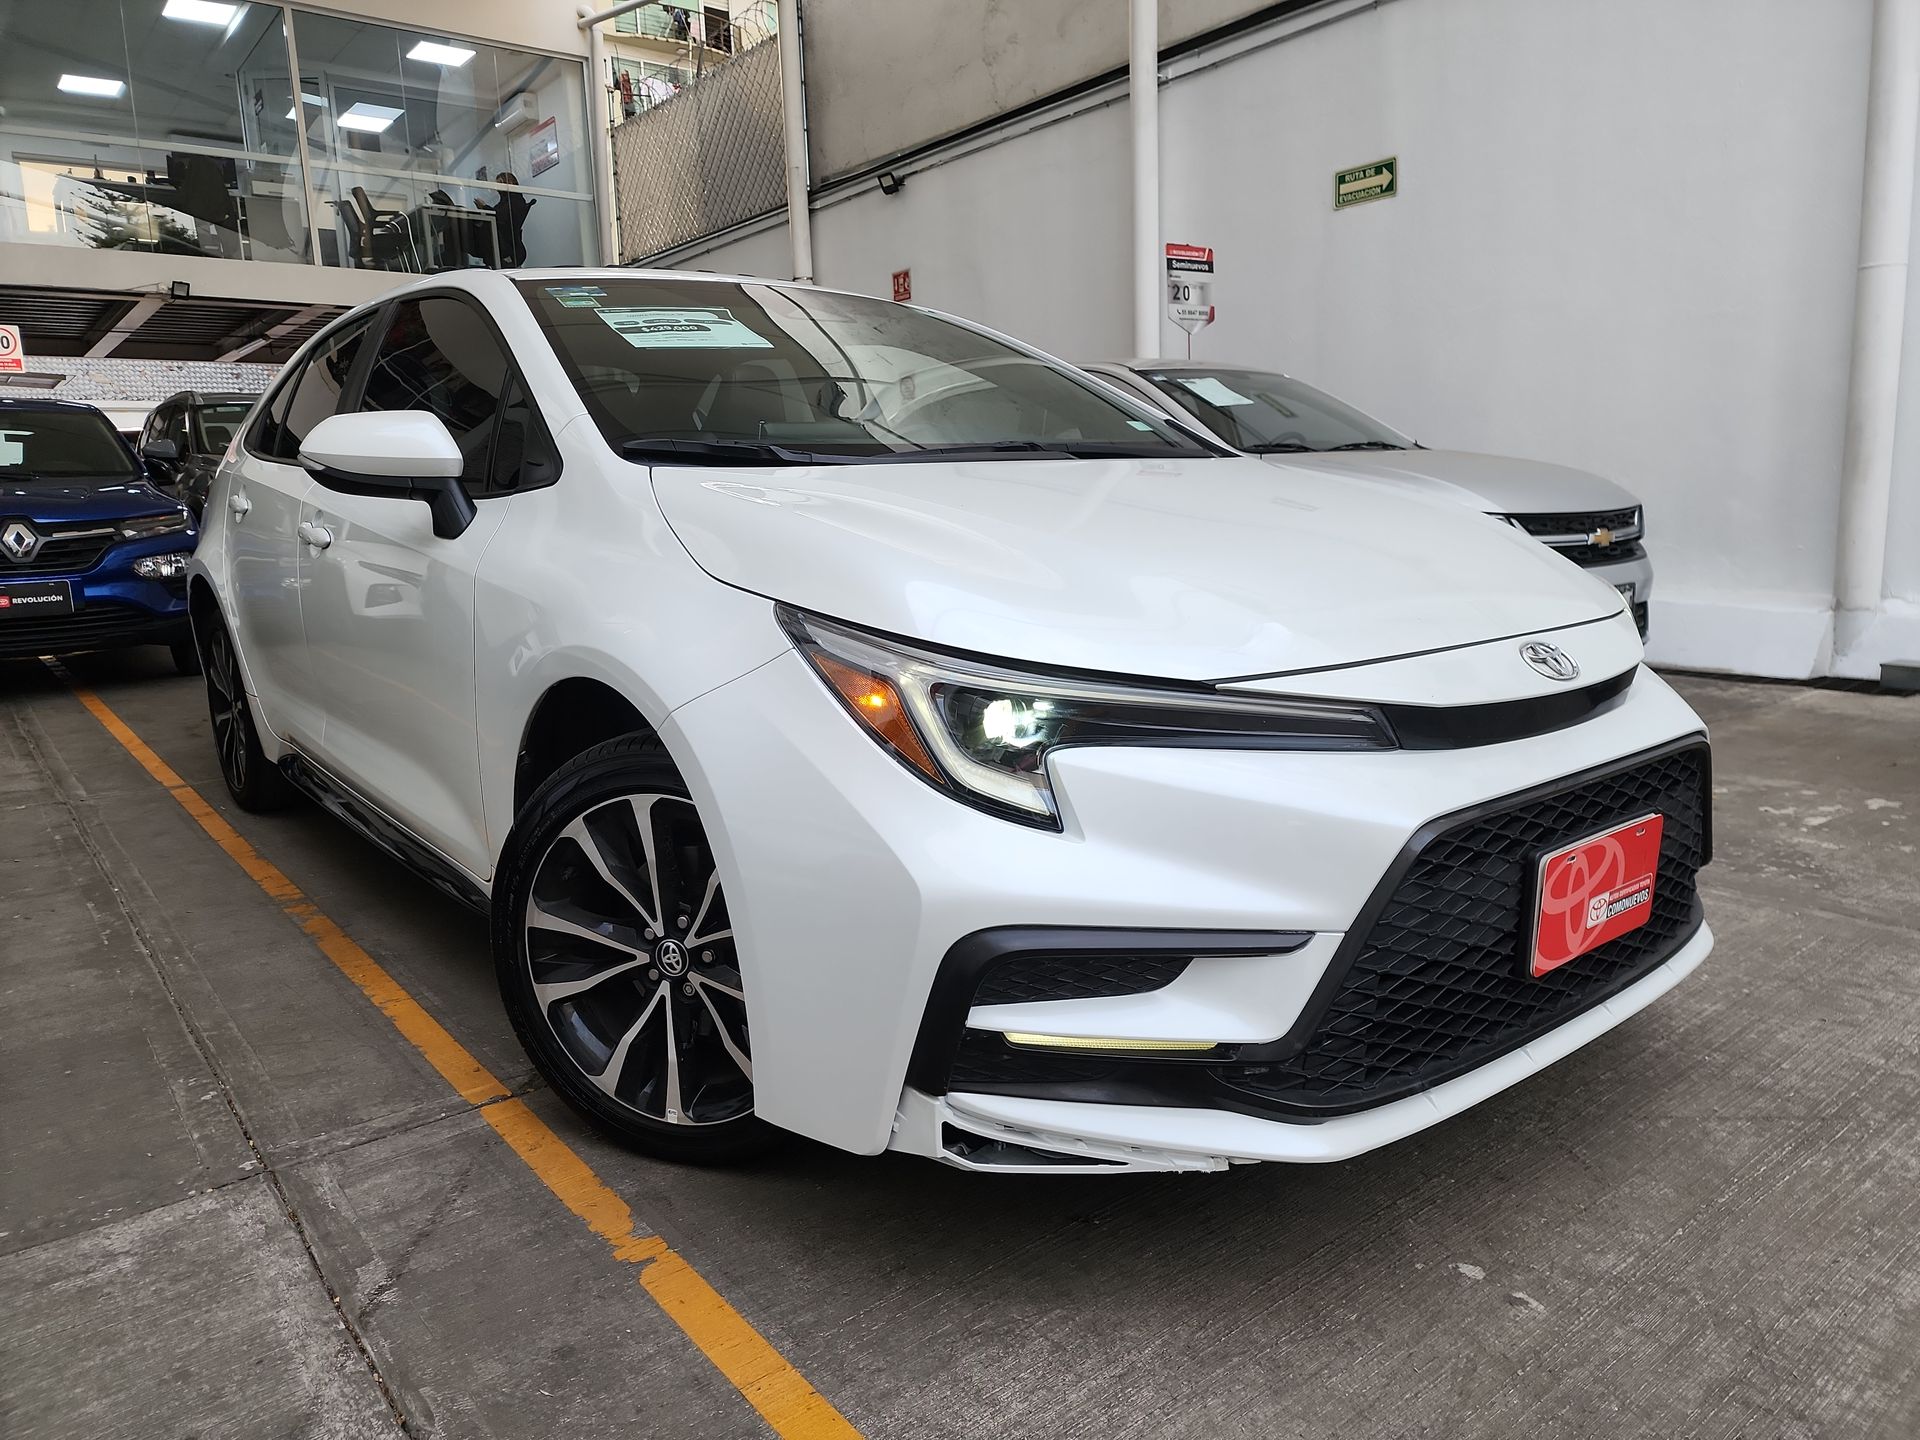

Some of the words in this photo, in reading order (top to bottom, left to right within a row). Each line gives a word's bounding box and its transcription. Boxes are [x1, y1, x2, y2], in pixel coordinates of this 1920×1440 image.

[1345, 171, 1364, 182] RUTA
[1365, 168, 1376, 177] DE
[1172, 260, 1209, 271] Seminuevos
[12, 594, 63, 604] REVOLUCIÓN
[1607, 888, 1649, 917] COMONUEVOS
